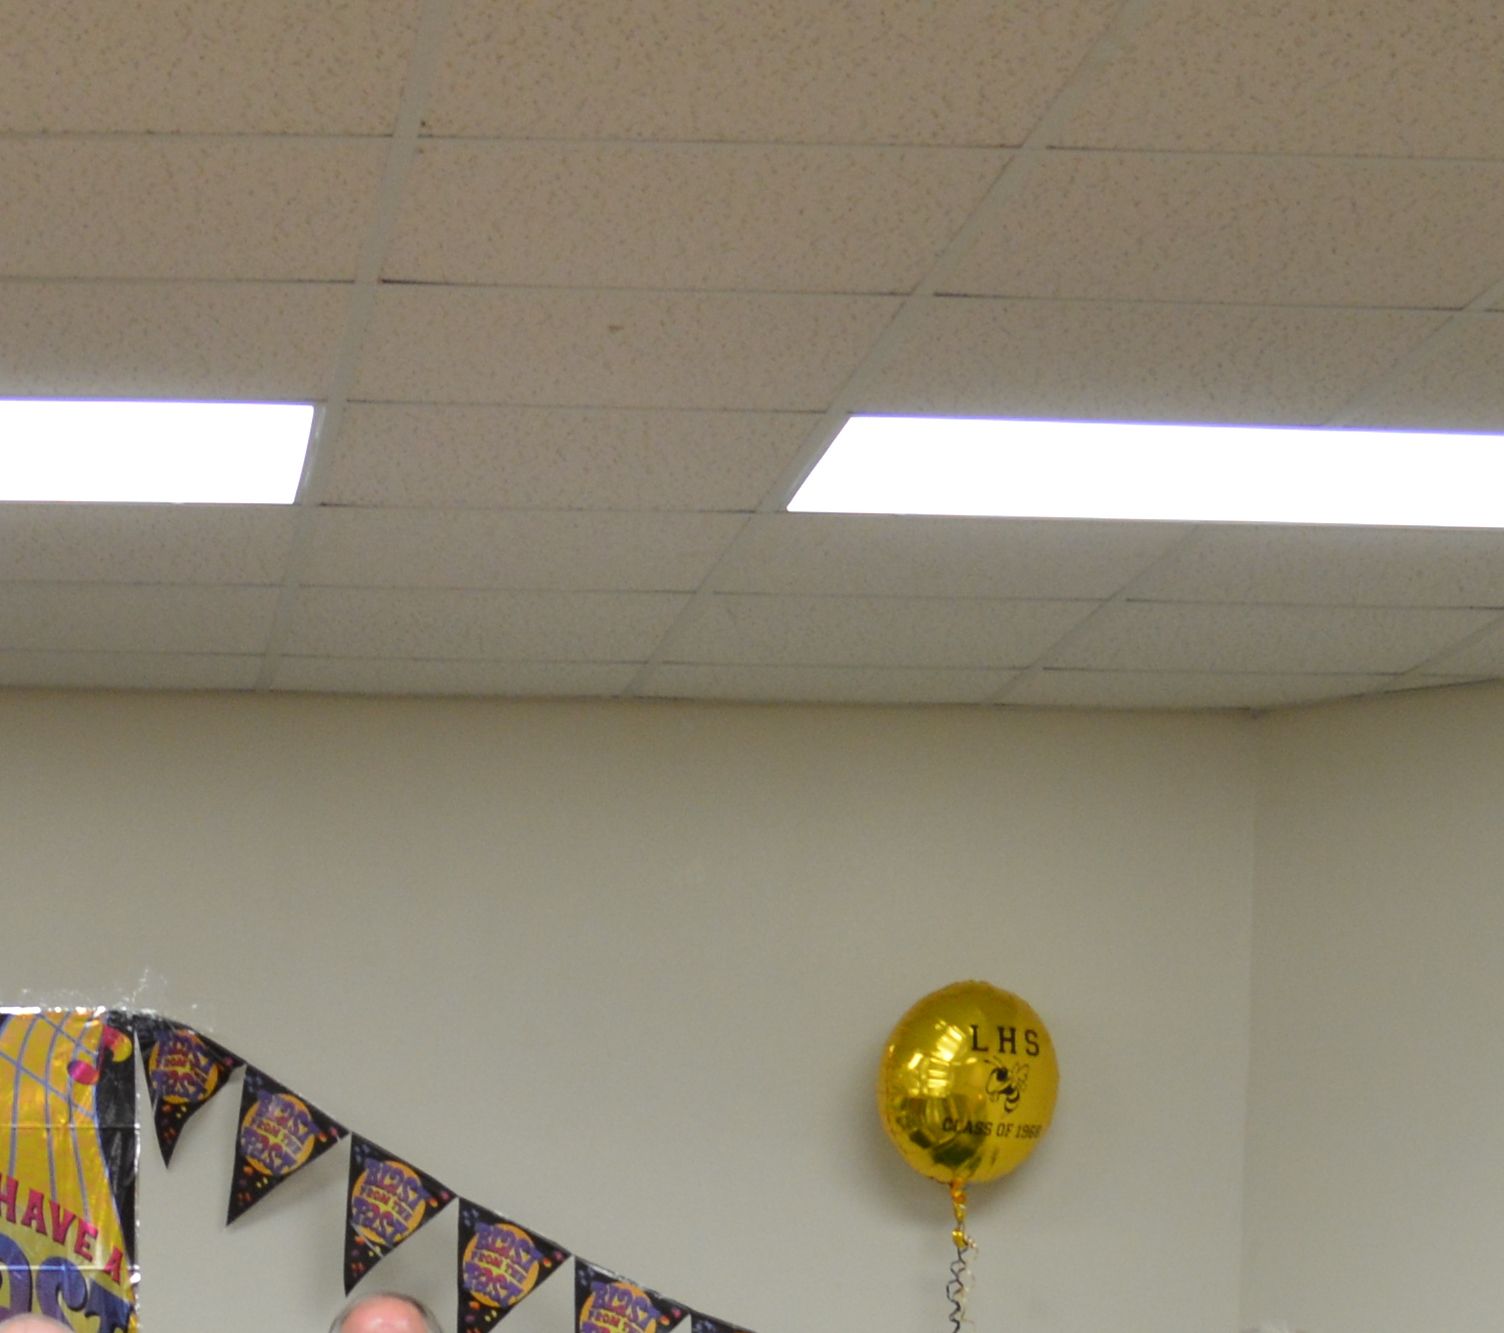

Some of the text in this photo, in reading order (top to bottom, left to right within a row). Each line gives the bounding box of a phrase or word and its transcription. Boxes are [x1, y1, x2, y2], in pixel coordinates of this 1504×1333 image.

[970, 1024, 1040, 1057] LHS
[942, 1117, 993, 1137] CLASS
[996, 1122, 1014, 1138] OF
[103, 1245, 124, 1286] A
